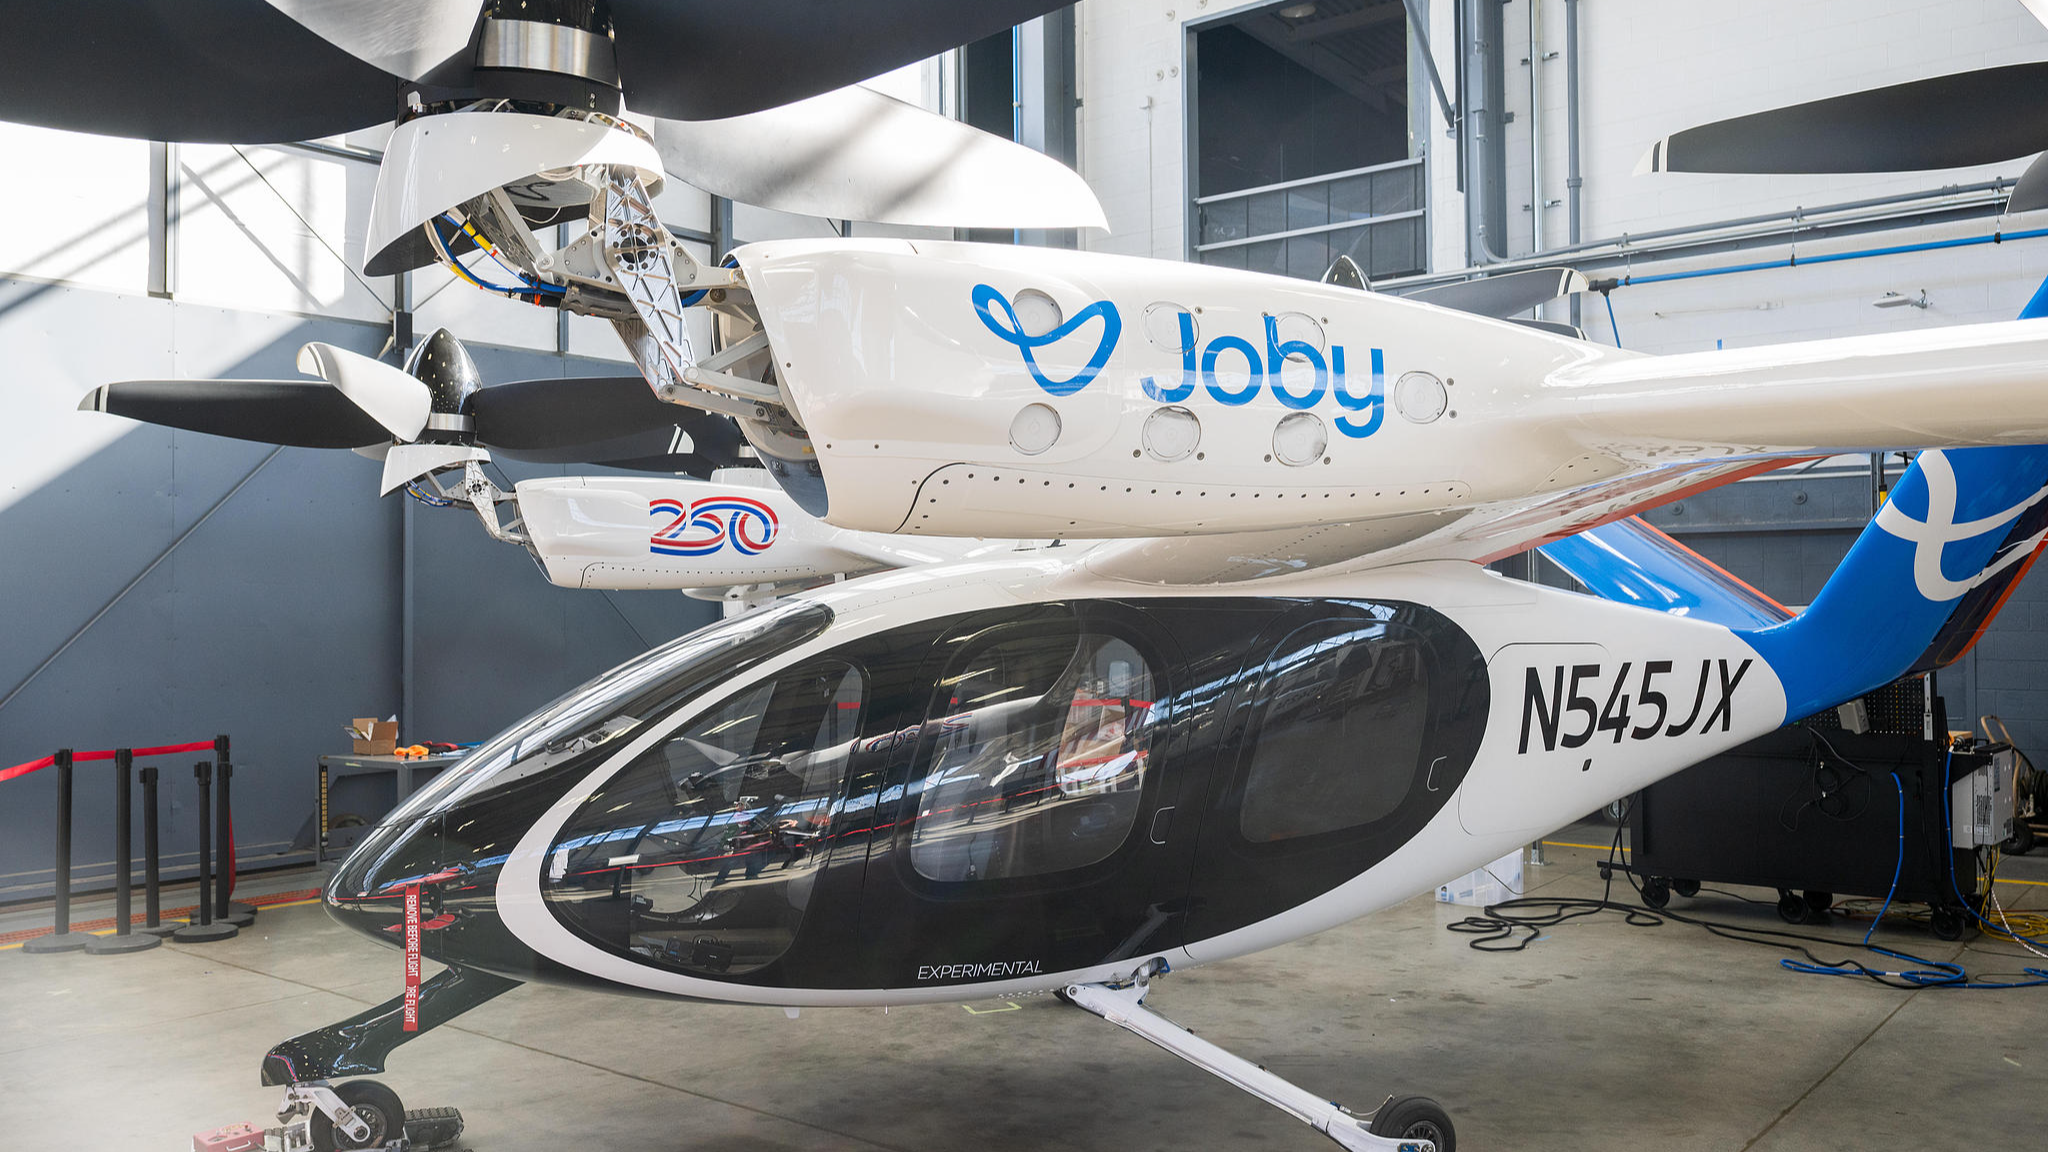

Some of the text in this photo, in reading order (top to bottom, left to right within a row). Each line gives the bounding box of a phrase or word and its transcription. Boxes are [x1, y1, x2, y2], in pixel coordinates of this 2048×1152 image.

[1139, 312, 1385, 439] Joby
[649, 496, 779, 557] 250
[1518, 659, 1753, 754] N545JX
[406, 894, 419, 977] REMOVE BEFORE FLIGHT
[917, 960, 1043, 980] EXPERIMENTAL
[405, 999, 416, 1023] FLIGHT
